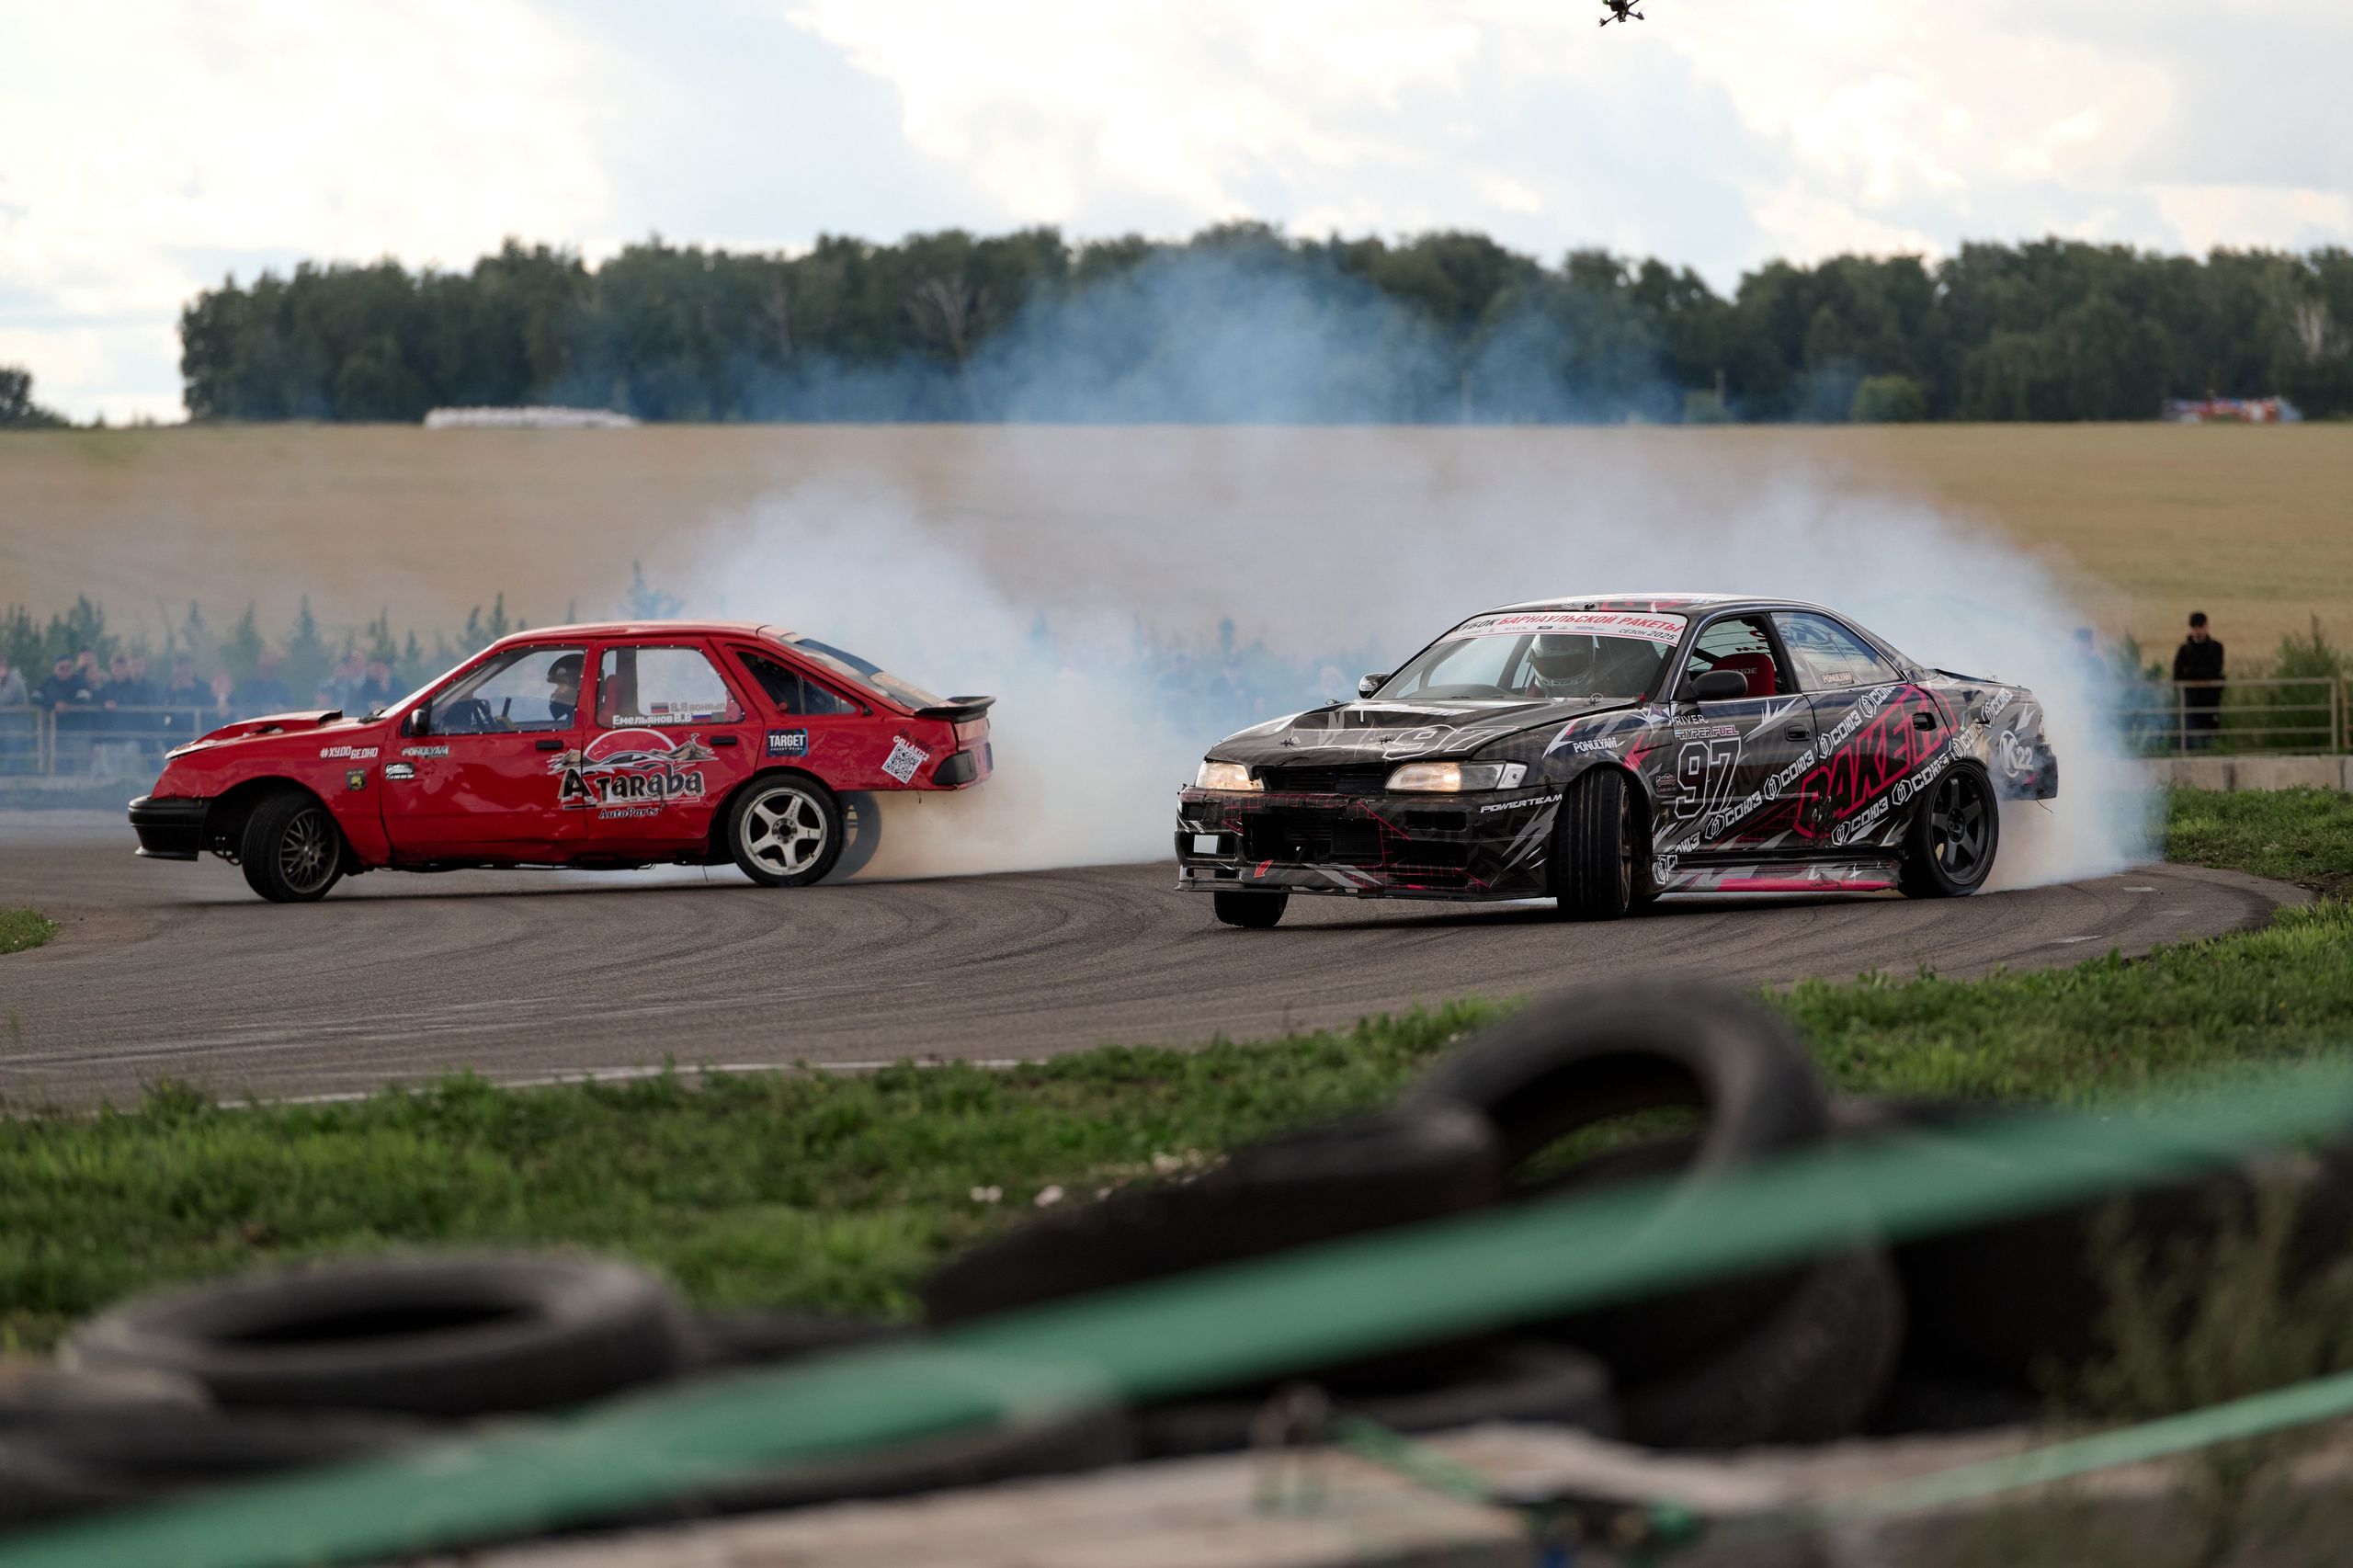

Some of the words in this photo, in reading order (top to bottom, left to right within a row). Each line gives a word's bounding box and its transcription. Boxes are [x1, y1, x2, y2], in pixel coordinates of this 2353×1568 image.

[1497, 615, 1620, 626] БАРНАУЛЬСКОЙ
[1619, 617, 1685, 632] РАКЕТЫ
[1618, 628, 1647, 636] СЕЗОН
[1647, 630, 1677, 642] 2025
[612, 714, 673, 726] Емельянов
[1674, 715, 1709, 726] RIVER
[1830, 709, 1863, 746] СОЮЗ
[768, 733, 805, 747] TARGET
[1382, 723, 1521, 761] 97
[1573, 736, 1618, 754] PONULYAM
[1779, 749, 1815, 788] СОЮЗ
[1674, 736, 1742, 820] 97
[598, 807, 659, 820] AutoParts
[1725, 790, 1763, 827] СОЮЗ
[1850, 796, 1890, 833] СОЮЗ
